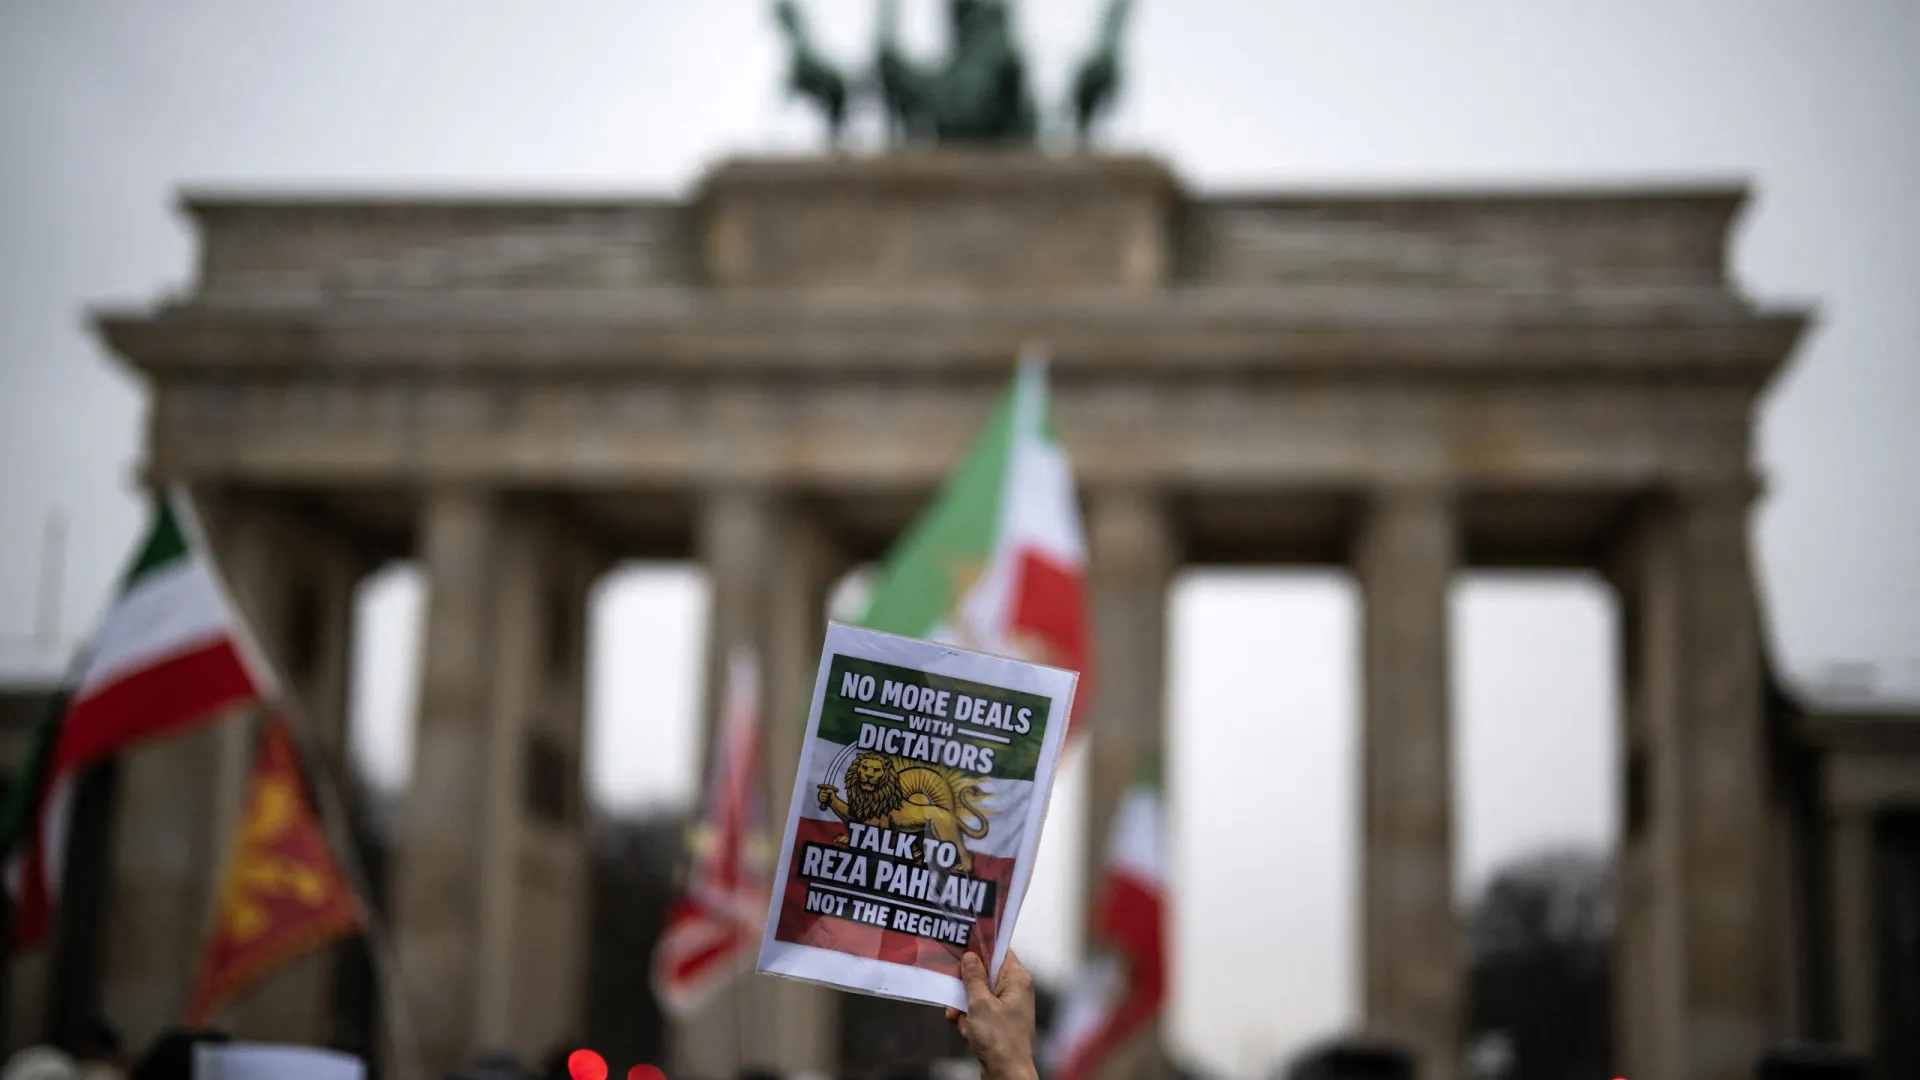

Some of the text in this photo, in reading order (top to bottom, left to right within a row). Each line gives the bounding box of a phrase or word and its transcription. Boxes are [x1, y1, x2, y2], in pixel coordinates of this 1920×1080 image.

[840, 672, 1032, 734] NO MORE DEALS
[909, 715, 953, 736] WITH
[858, 723, 994, 773] DICTATORS
[849, 822, 956, 868] TALK TO
[803, 846, 987, 913] REZA PAHLAVI
[806, 891, 970, 944] NOT THE REGIME
